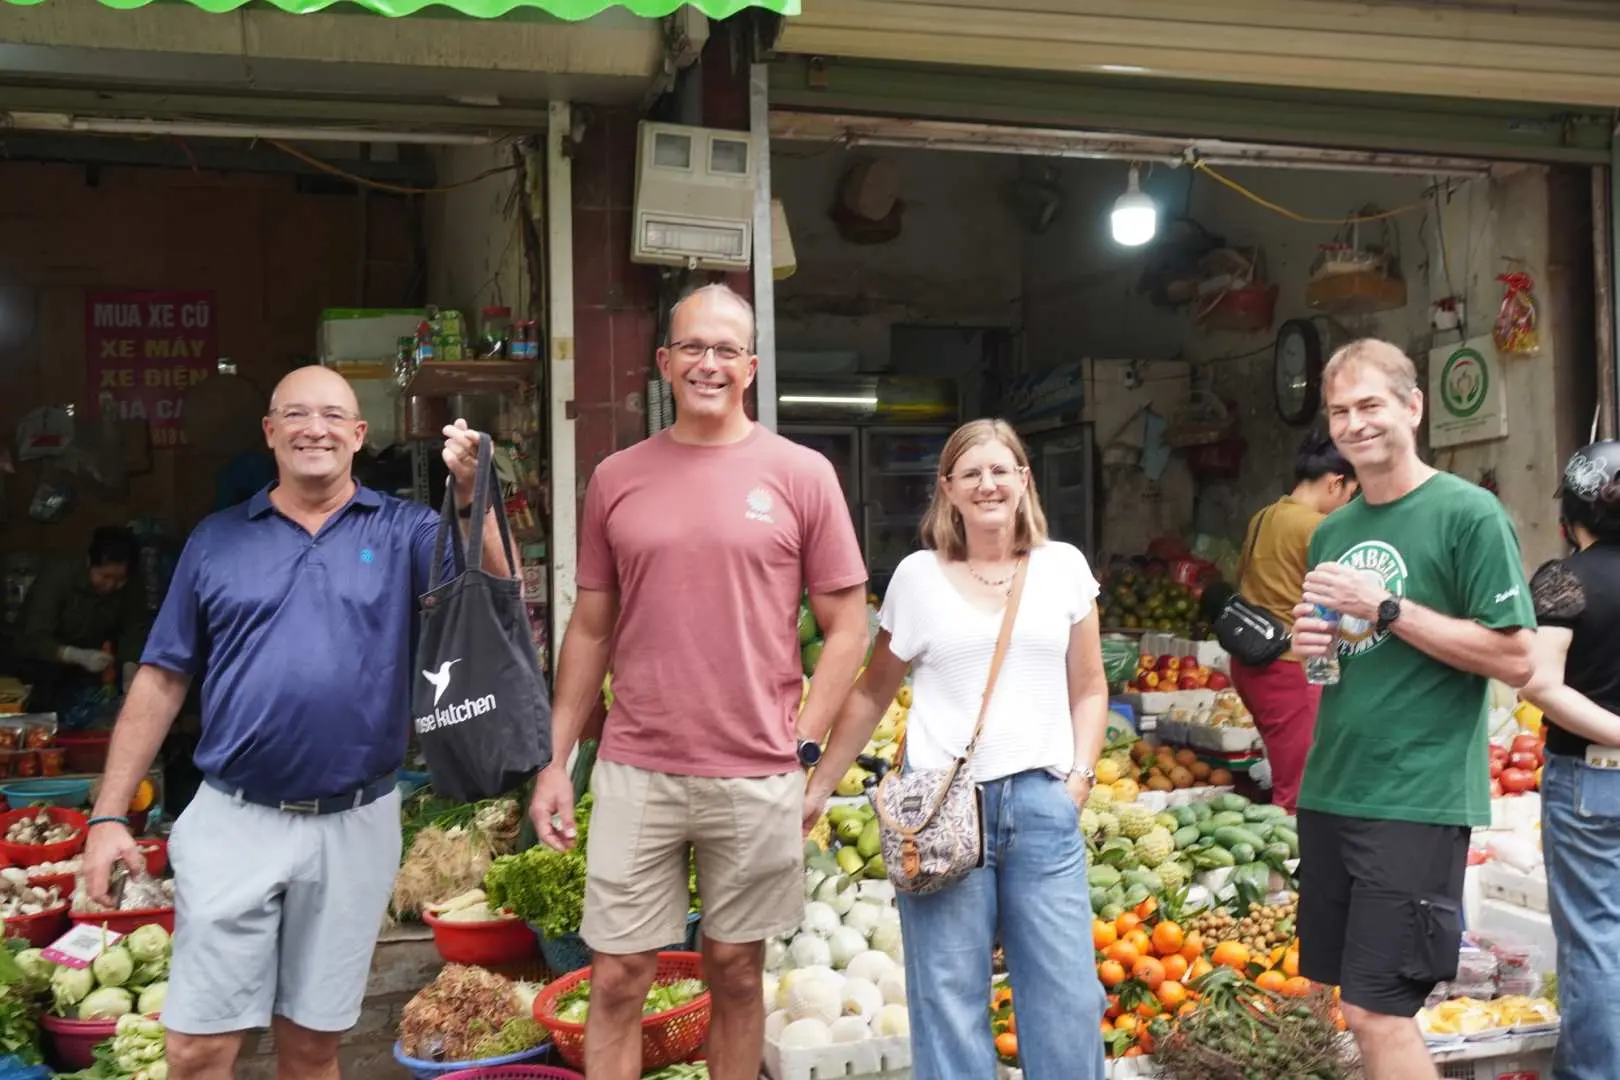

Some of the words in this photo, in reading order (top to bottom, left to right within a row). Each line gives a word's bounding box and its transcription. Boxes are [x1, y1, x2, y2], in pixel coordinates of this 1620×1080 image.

[94, 303, 141, 328] MUA
[148, 303, 174, 328] XE
[181, 300, 210, 328] CŨ
[101, 340, 136, 358] XE
[144, 336, 205, 358] MÁY
[101, 369, 136, 388] XE
[1343, 548, 1399, 583] MBEZI
